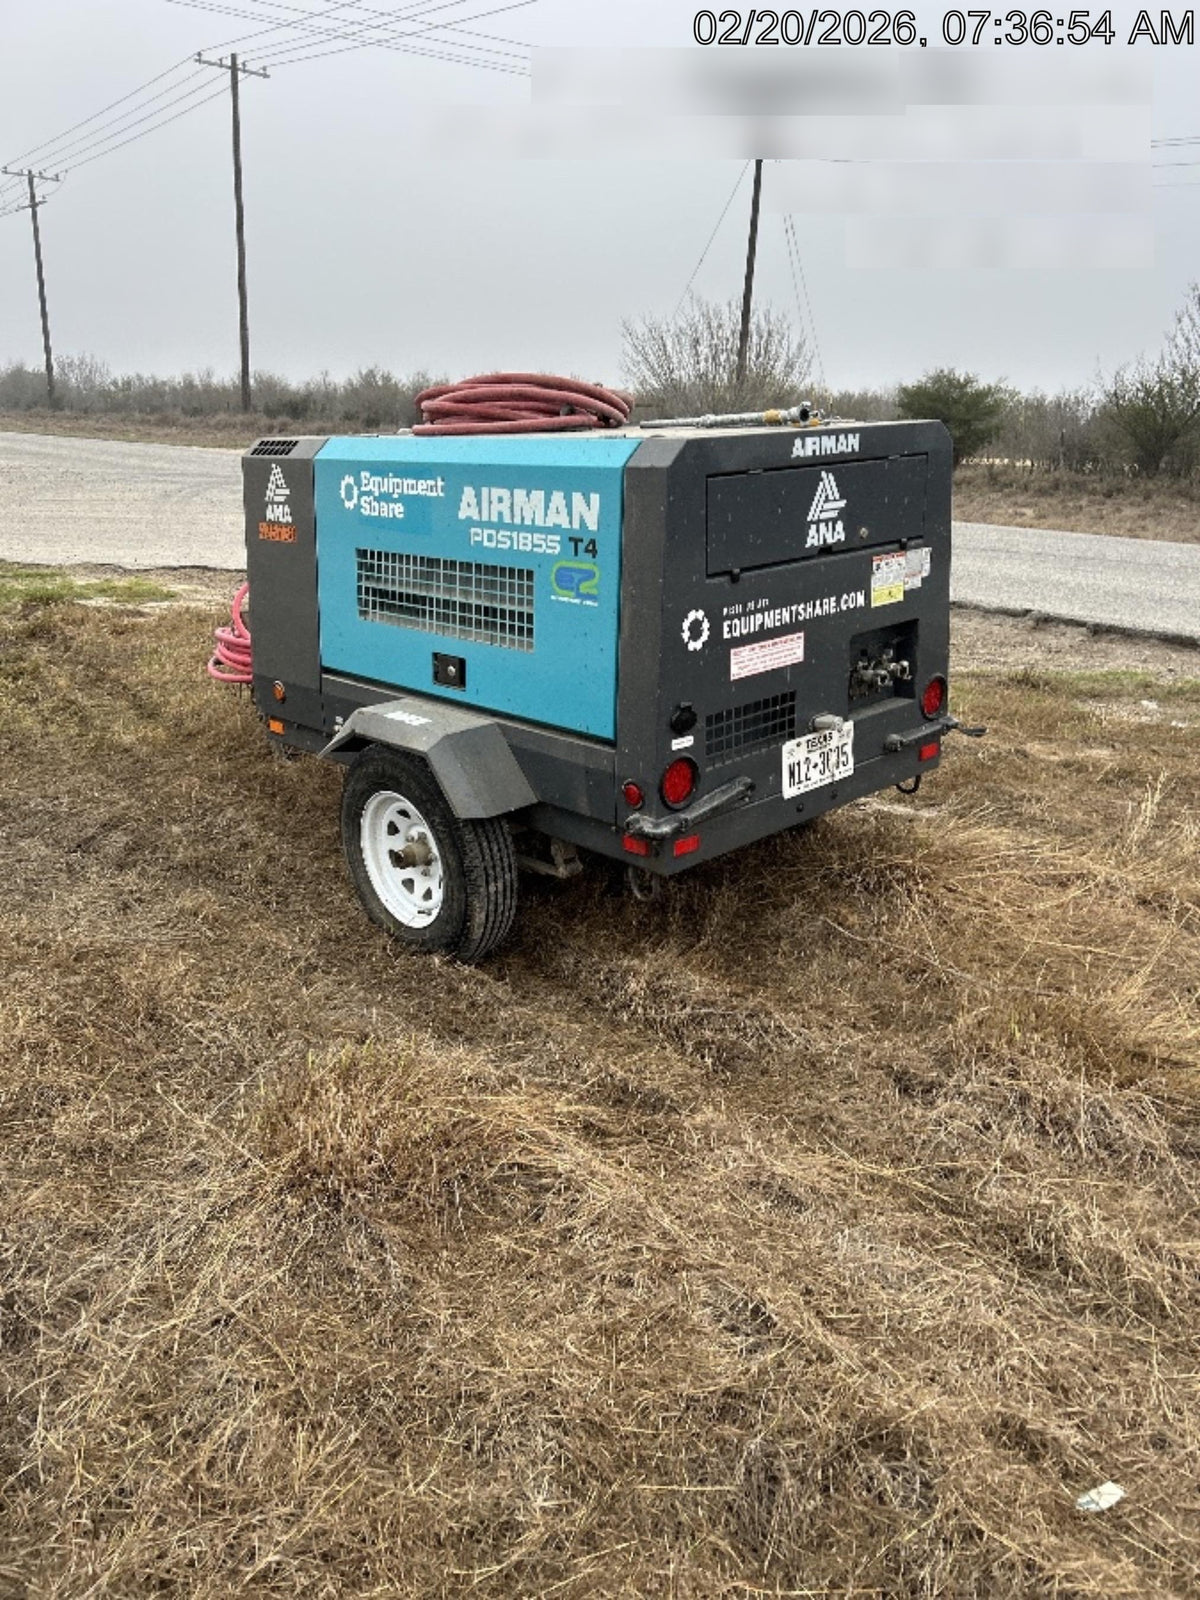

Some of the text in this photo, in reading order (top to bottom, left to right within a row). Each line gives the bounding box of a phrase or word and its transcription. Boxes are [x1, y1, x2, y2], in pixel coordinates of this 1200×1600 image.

[791, 433, 860, 458] AIRMAN
[361, 471, 445, 498] Equipment
[361, 496, 404, 518] Share
[458, 486, 600, 531] AIRMAN
[805, 520, 845, 548] ANA
[569, 537, 599, 559] T4
[722, 590, 865, 639] EQUIPMENTSHARE.COM
